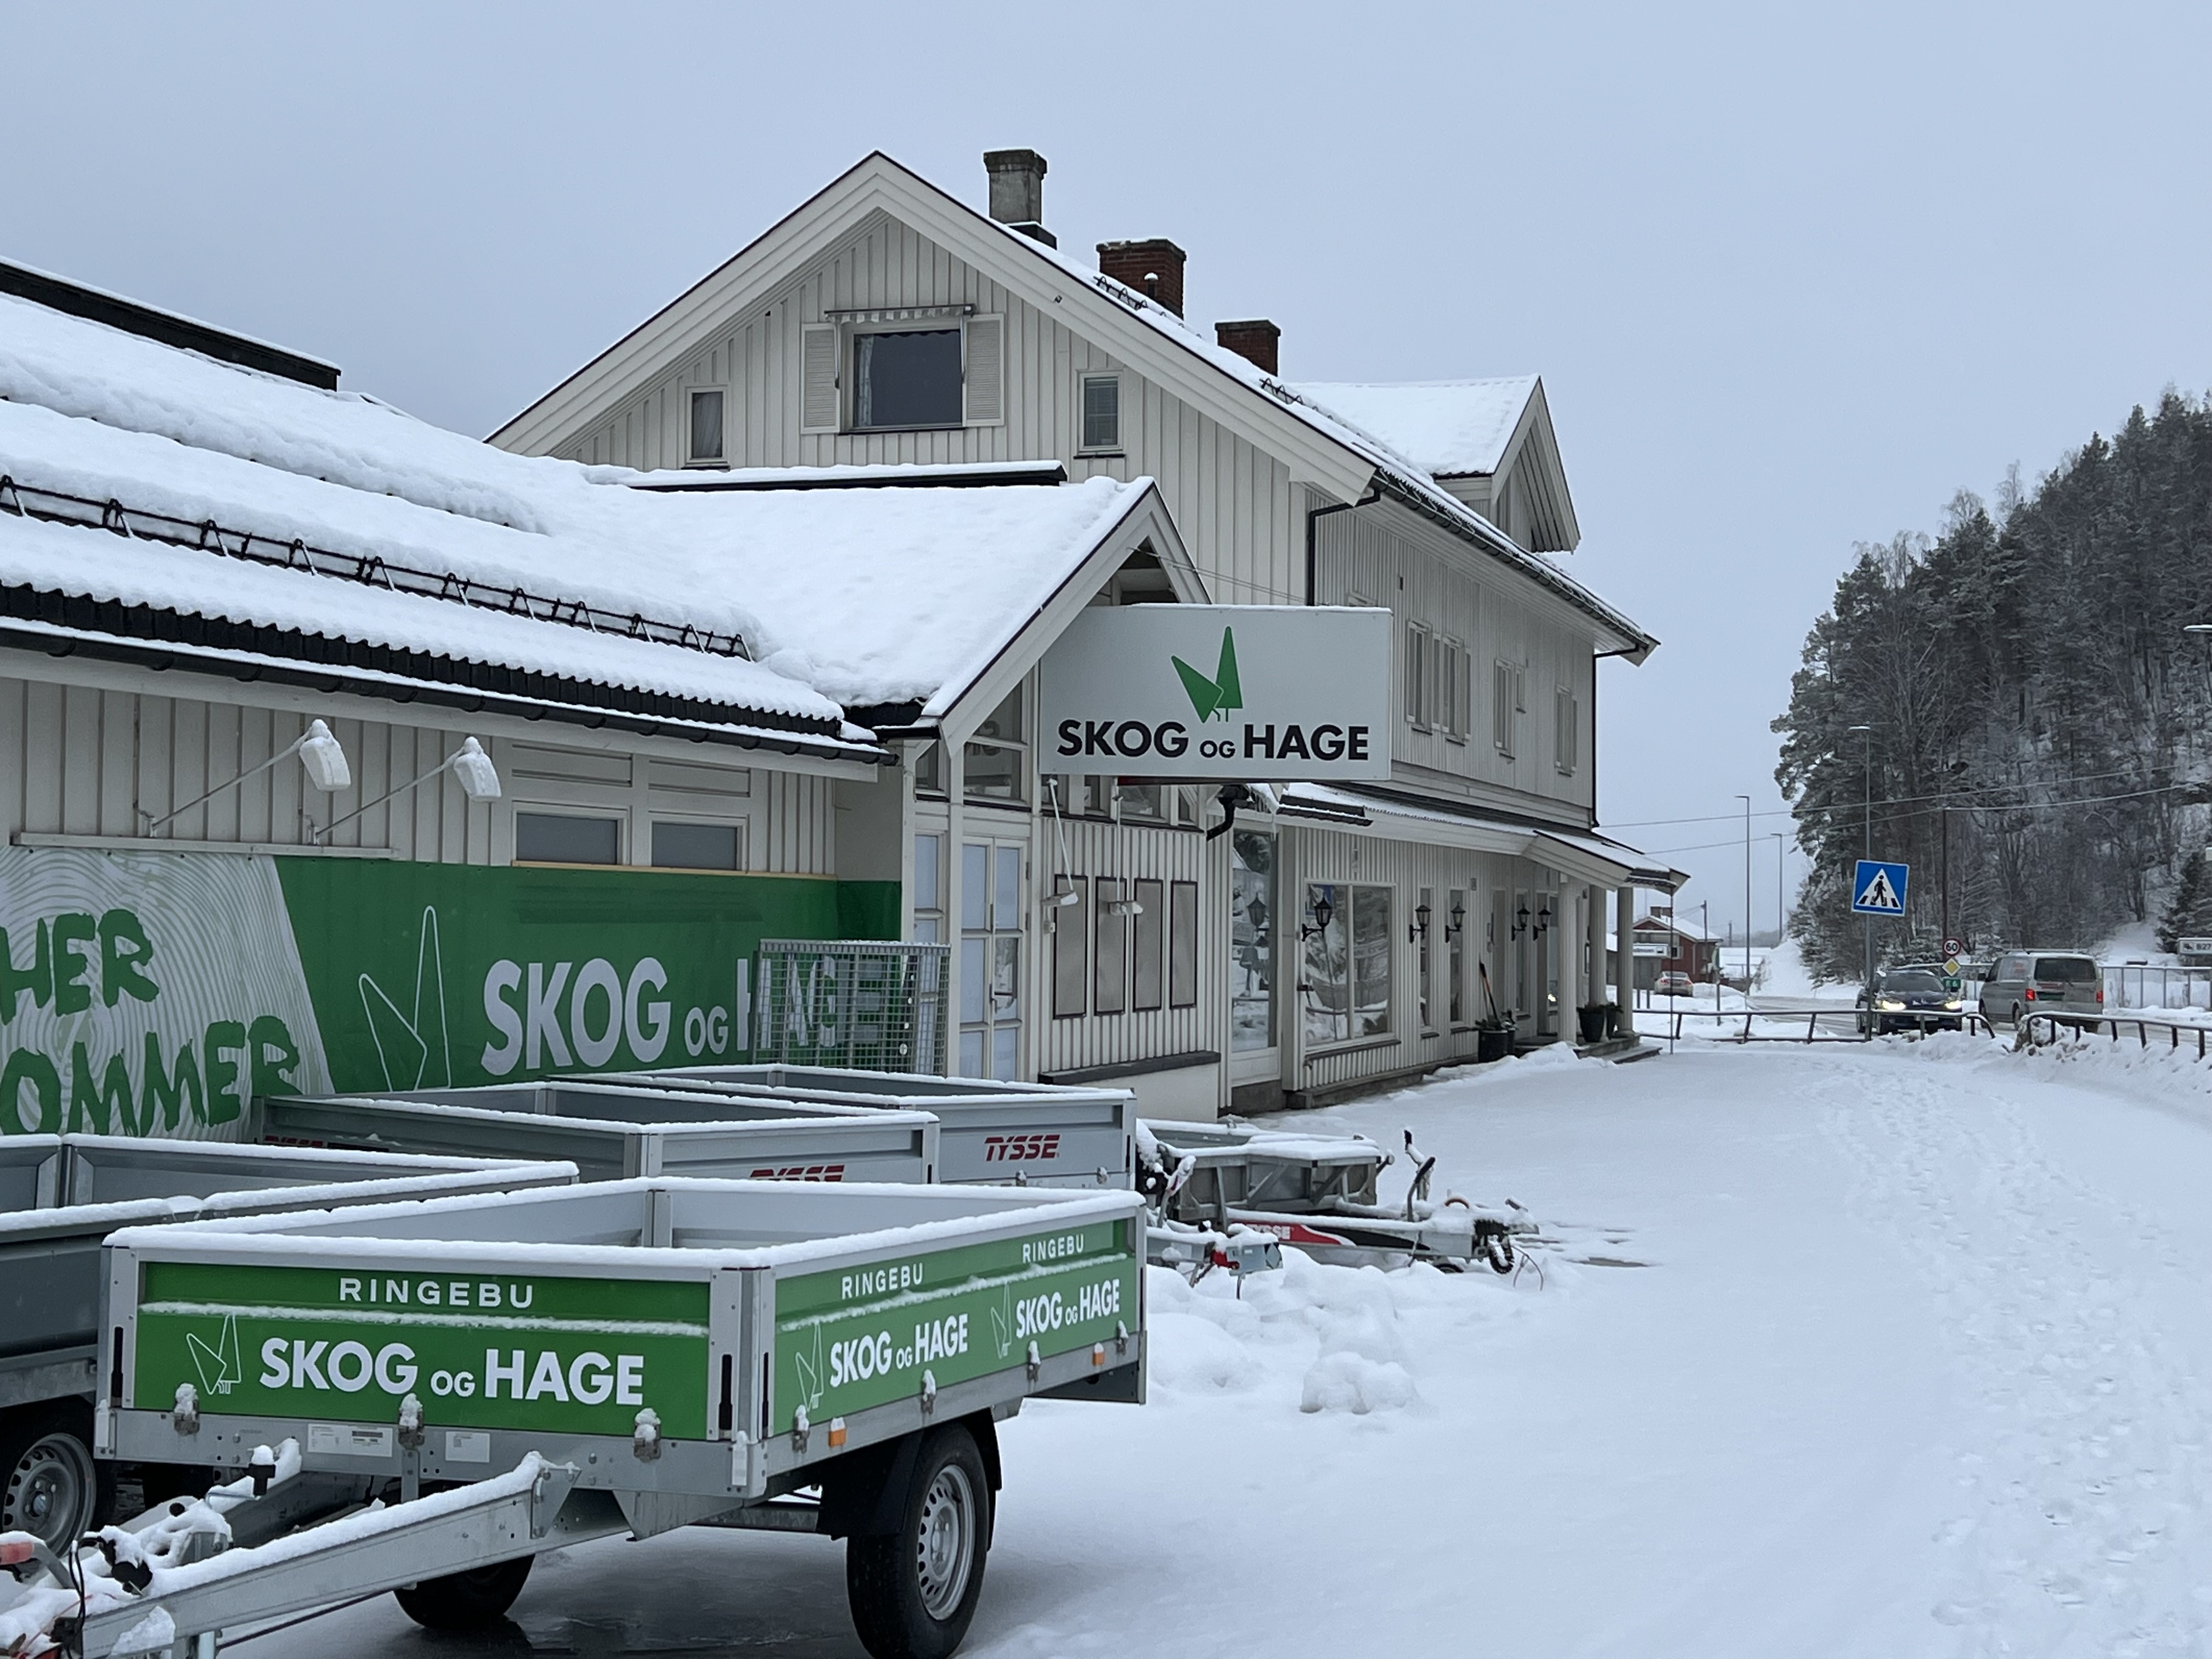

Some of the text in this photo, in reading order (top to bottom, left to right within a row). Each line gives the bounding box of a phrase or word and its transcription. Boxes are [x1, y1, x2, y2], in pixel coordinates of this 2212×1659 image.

[1057, 719, 1369, 761] SKOG OG HAGE
[1946, 943, 1959, 951] 60
[481, 957, 671, 1075] SKOG
[684, 1006, 729, 1057] OG
[985, 1134, 1060, 1161] TYSSE
[1023, 1234, 1084, 1263] RINGEBU
[339, 1278, 533, 1308] RINGEBU
[842, 1262, 924, 1299] RINGEBU
[1016, 1279, 1120, 1339] SKOG OG HAGE
[830, 1313, 968, 1388] SKOG OG HAGE
[259, 1338, 644, 1406] SKOG OG HAGE
